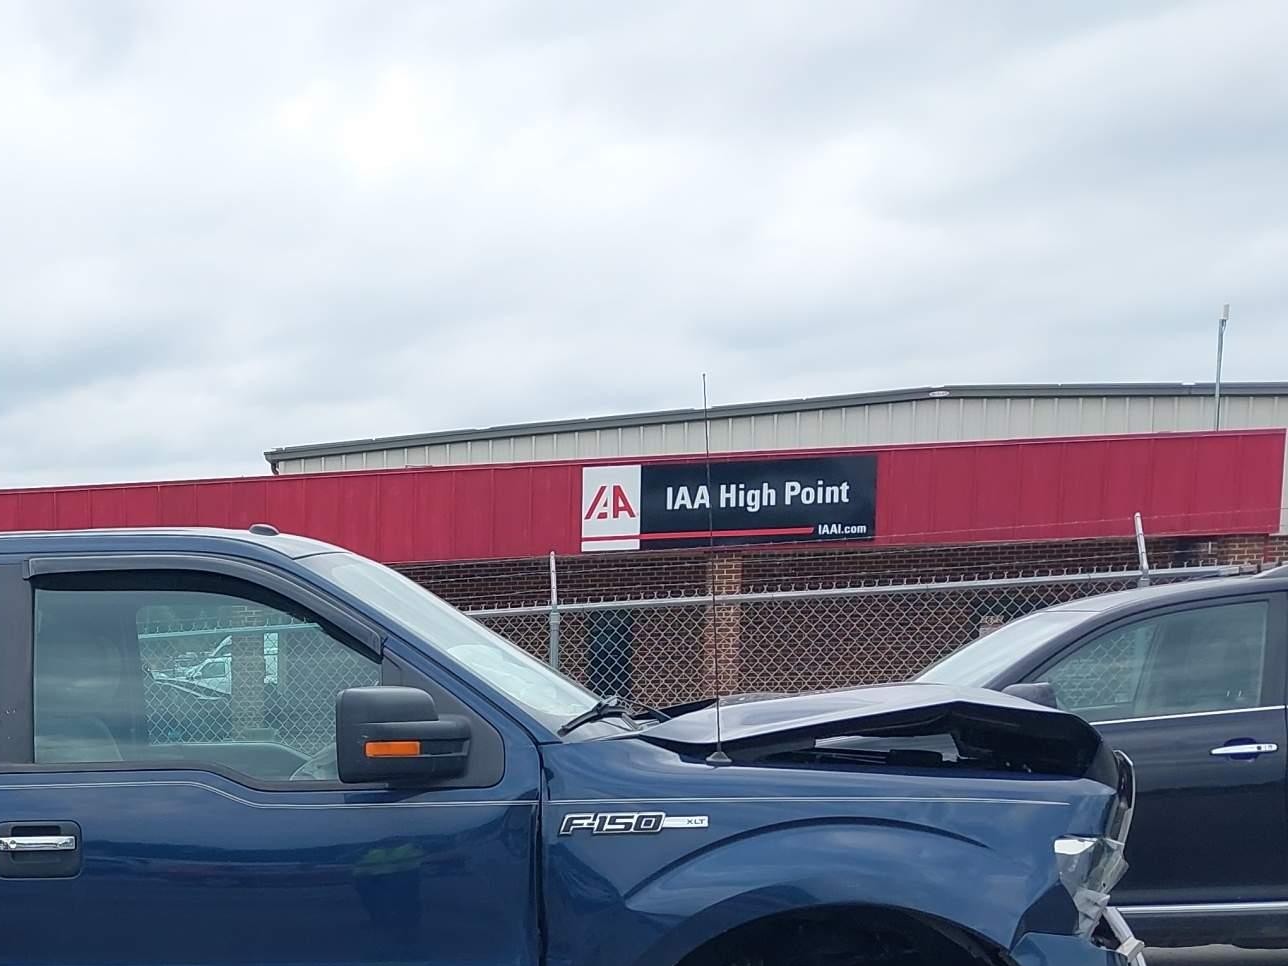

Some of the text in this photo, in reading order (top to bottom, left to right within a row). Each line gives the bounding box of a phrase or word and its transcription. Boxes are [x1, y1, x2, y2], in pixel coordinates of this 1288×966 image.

[666, 480, 850, 513] IAA High Point
[560, 812, 706, 835] F-150 XLT
